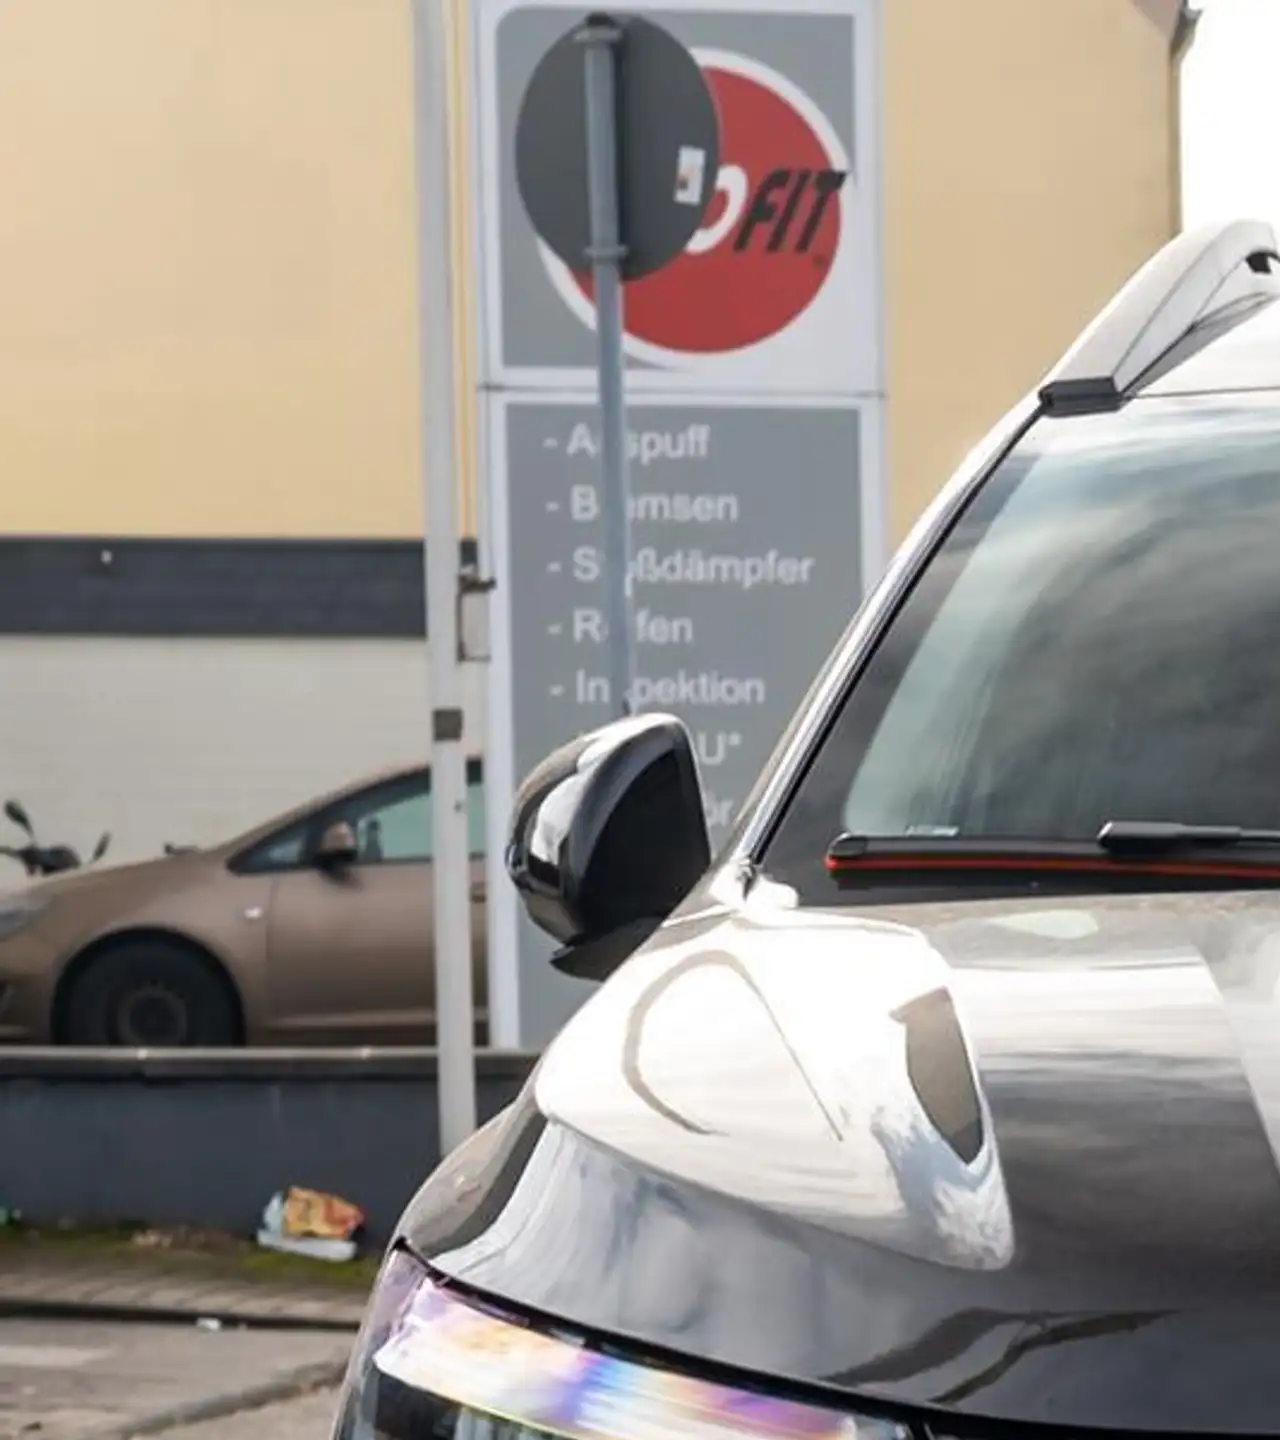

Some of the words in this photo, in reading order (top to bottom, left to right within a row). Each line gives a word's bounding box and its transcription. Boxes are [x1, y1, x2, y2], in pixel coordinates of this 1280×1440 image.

[566, 423, 711, 466] Aspuff
[571, 484, 739, 522] Bmsen
[573, 608, 694, 644] Rfen
[576, 669, 766, 711] Inpektion
